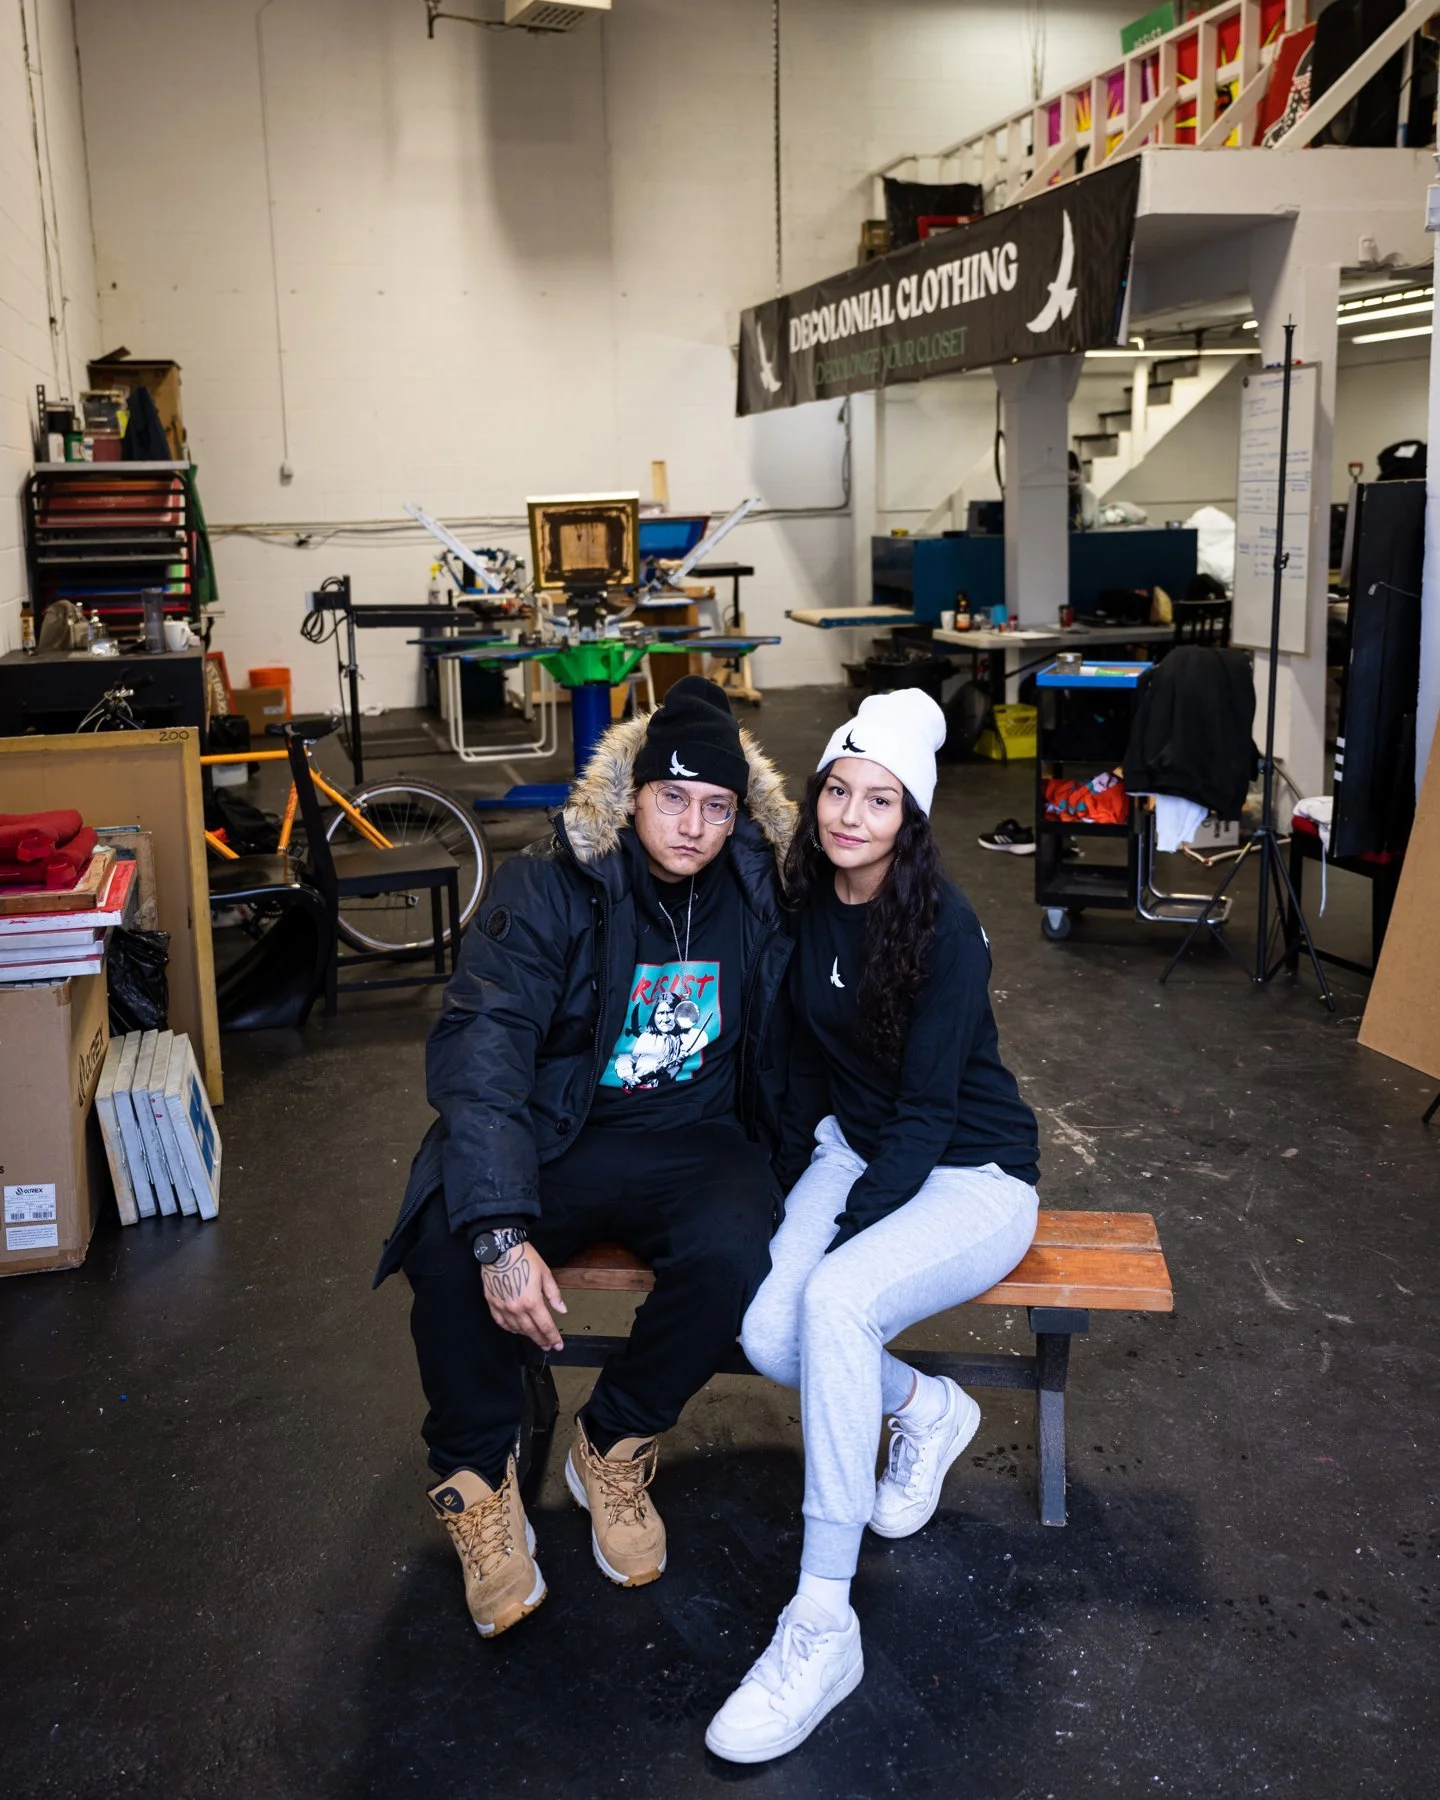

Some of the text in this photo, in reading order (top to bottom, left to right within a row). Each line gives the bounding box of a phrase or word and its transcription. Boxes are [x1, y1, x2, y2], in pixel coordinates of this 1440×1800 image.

[789, 241, 1019, 354] DECOLONIAL CLOTHING
[916, 326, 968, 363] CLOSET
[159, 730, 190, 742] 200
